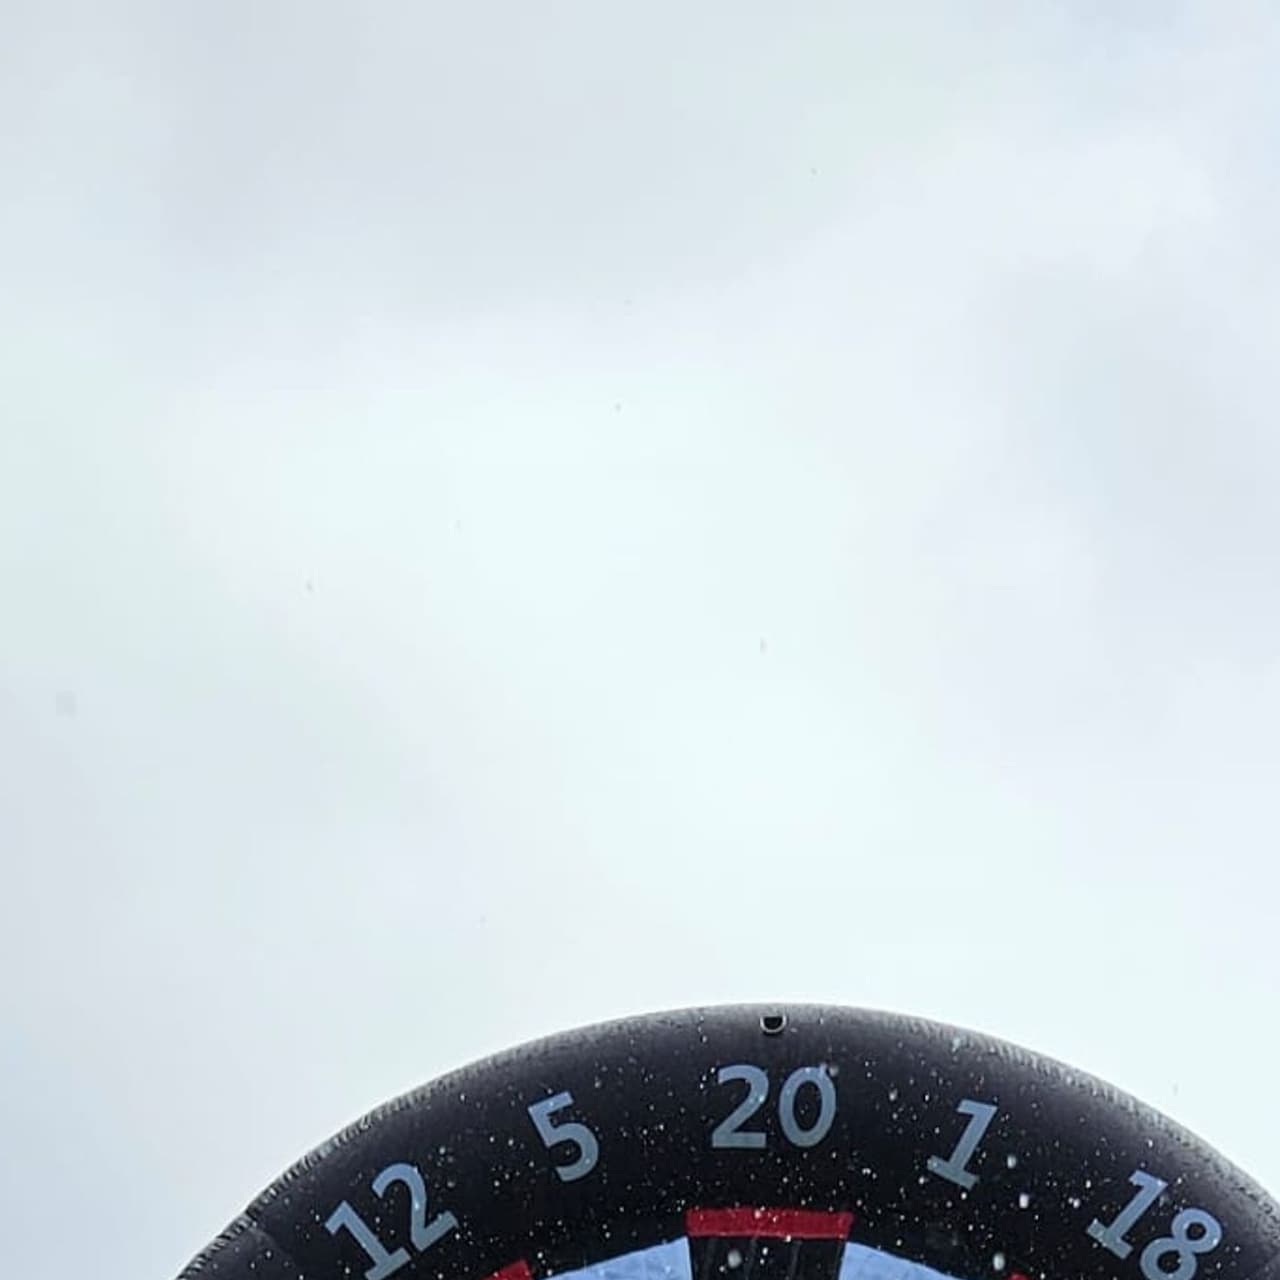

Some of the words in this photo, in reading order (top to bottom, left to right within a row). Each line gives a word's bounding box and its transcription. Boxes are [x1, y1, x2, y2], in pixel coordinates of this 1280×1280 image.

[528, 1091, 598, 1181] 5
[712, 1062, 836, 1147] 20
[927, 1099, 997, 1189] 1
